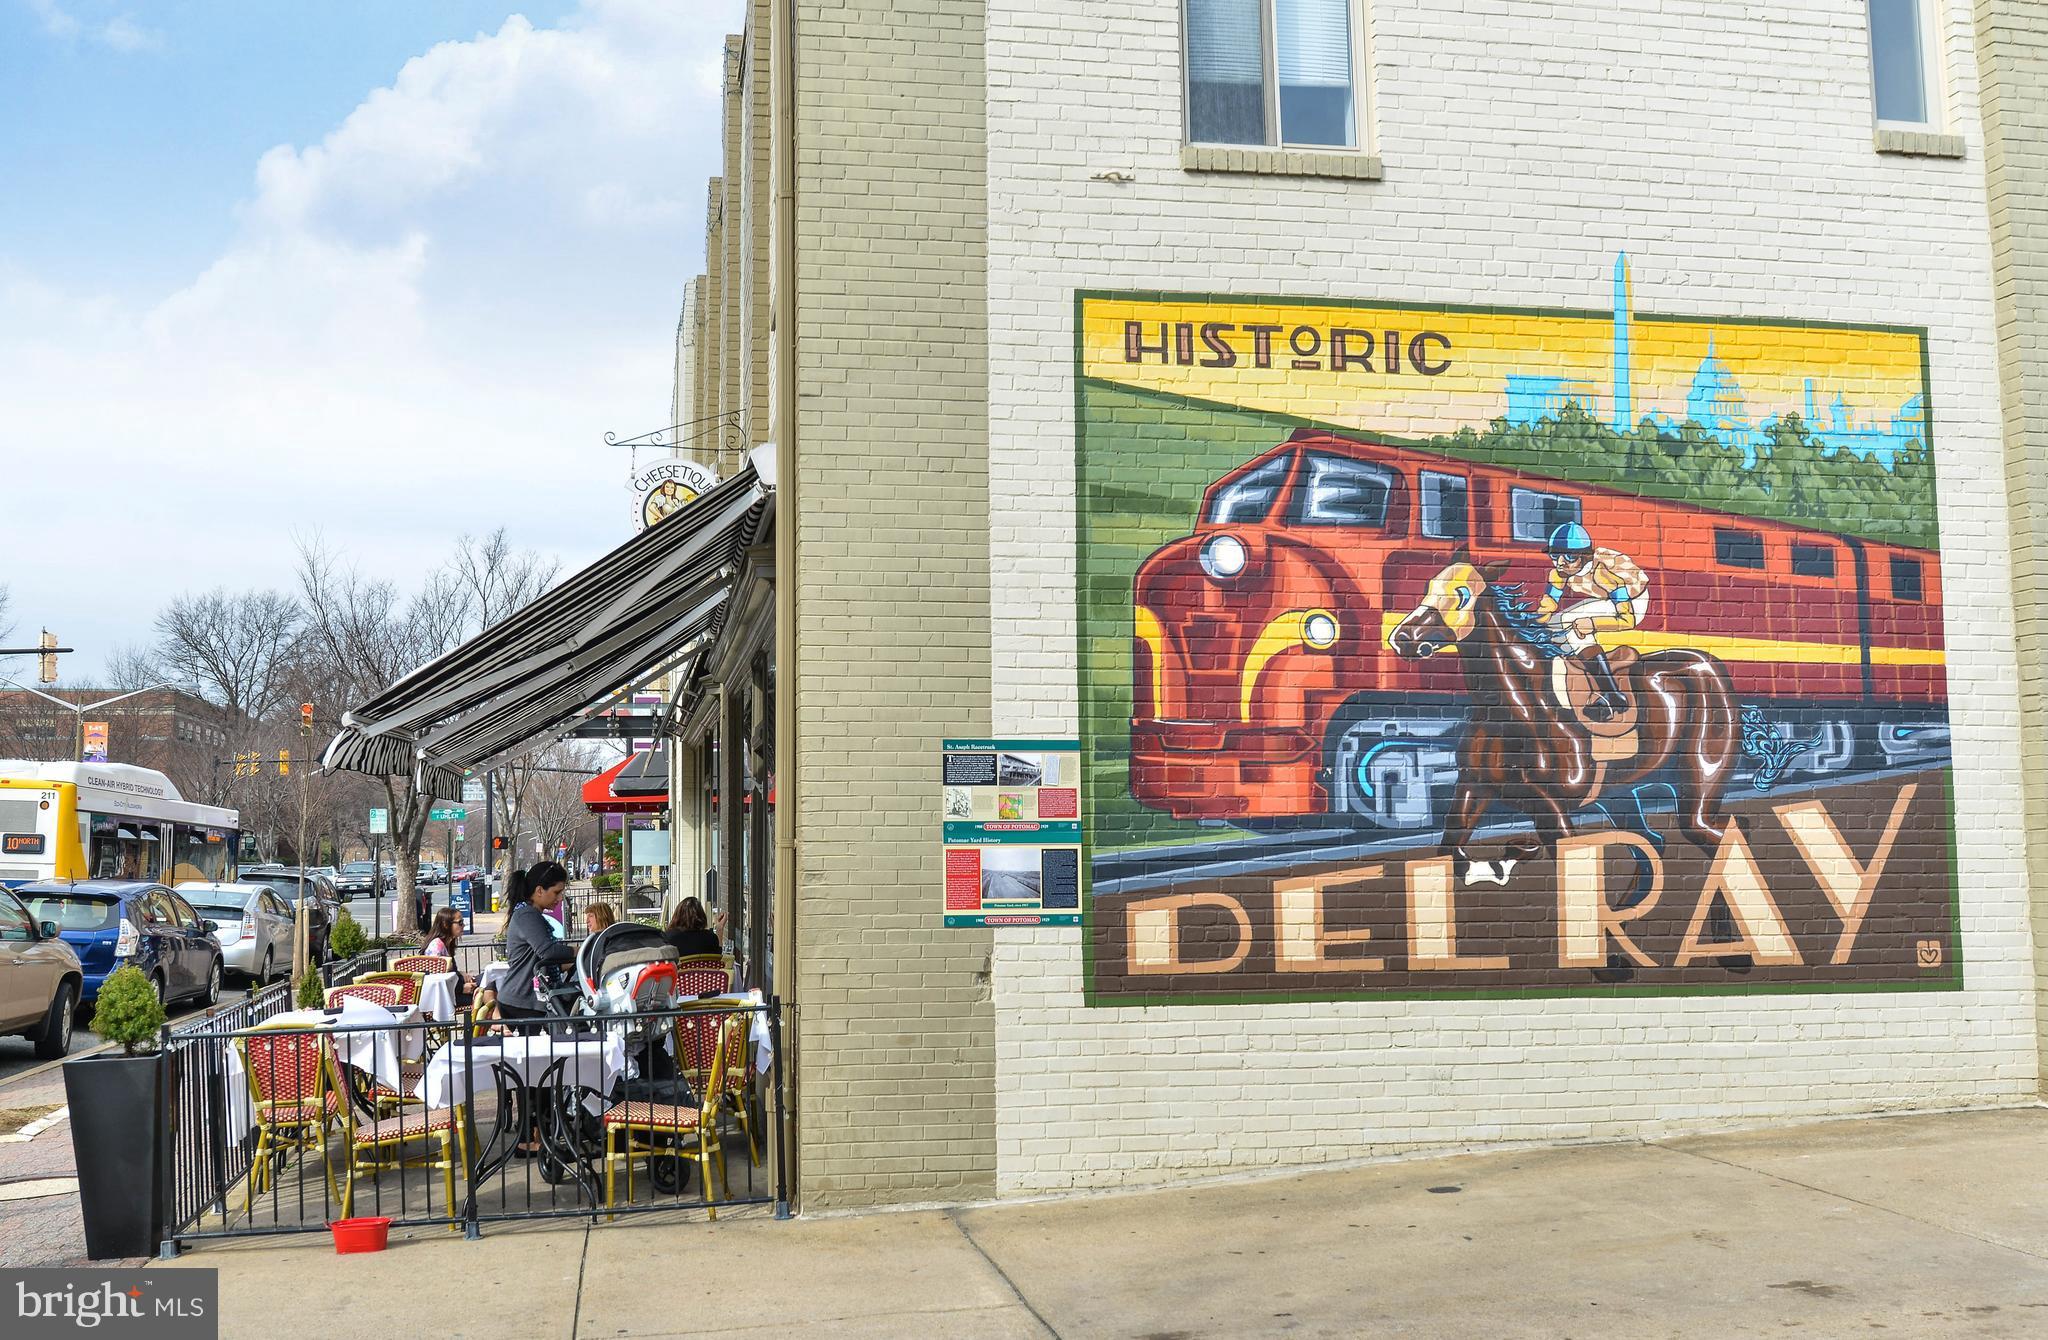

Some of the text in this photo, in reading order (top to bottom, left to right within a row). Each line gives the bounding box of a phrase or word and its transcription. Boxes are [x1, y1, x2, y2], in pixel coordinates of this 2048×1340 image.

[1124, 320, 1452, 376] HISTORIC
[87, 776, 164, 797] CLEAN-AIR HYBRID TECHNOLOGY
[41, 791, 56, 800] 211
[7, 837, 39, 850] 10 NORTH
[983, 837, 1001, 845] History
[1126, 783, 1918, 975] DEL RAY
